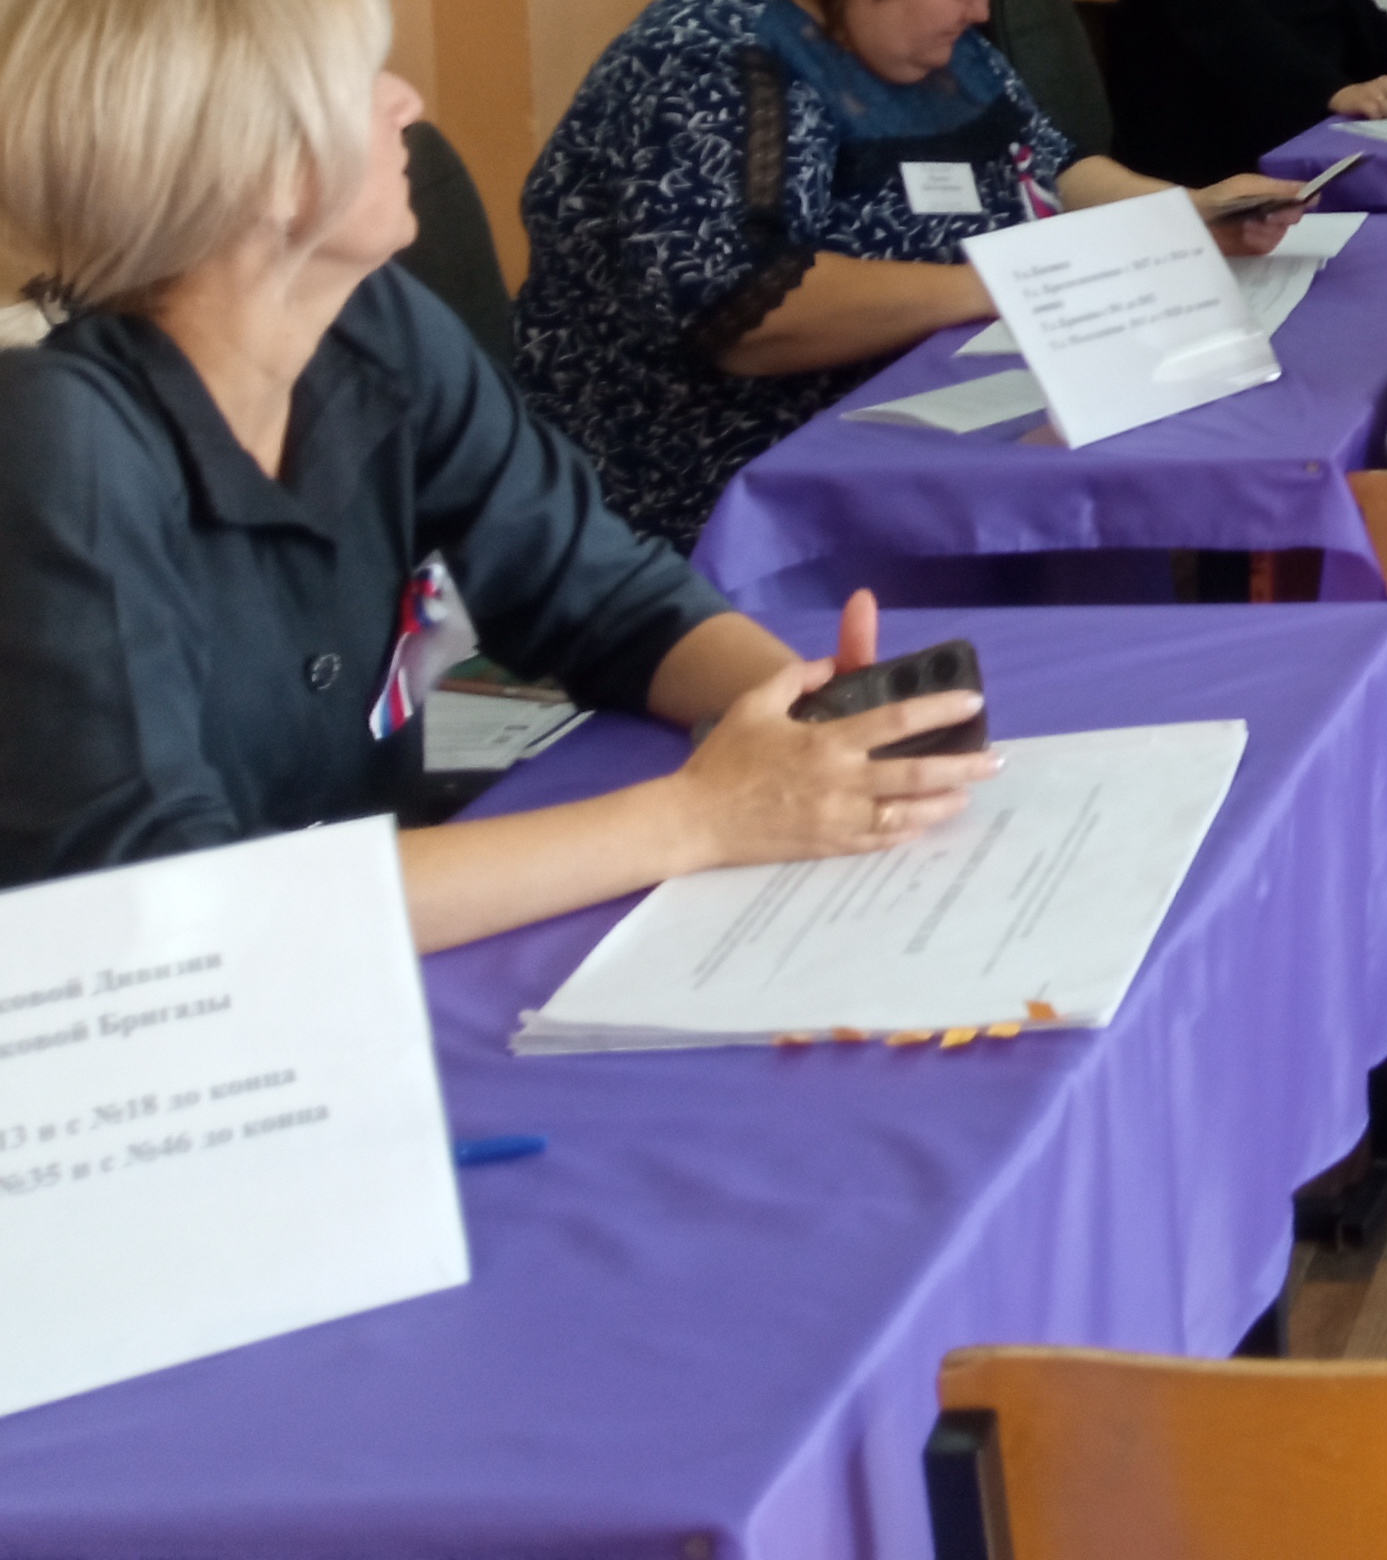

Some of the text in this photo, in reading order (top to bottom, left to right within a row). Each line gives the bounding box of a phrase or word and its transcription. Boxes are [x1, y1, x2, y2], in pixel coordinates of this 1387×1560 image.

[92, 952, 222, 996] Дивизии
[98, 994, 231, 1038] Бригады
[65, 1118, 80, 1135] с
[91, 1094, 158, 1129] №18
[168, 1090, 200, 1111] до
[209, 1068, 296, 1100] конца
[99, 1155, 114, 1173] с
[202, 1127, 233, 1149] до
[241, 1104, 329, 1139] конца
